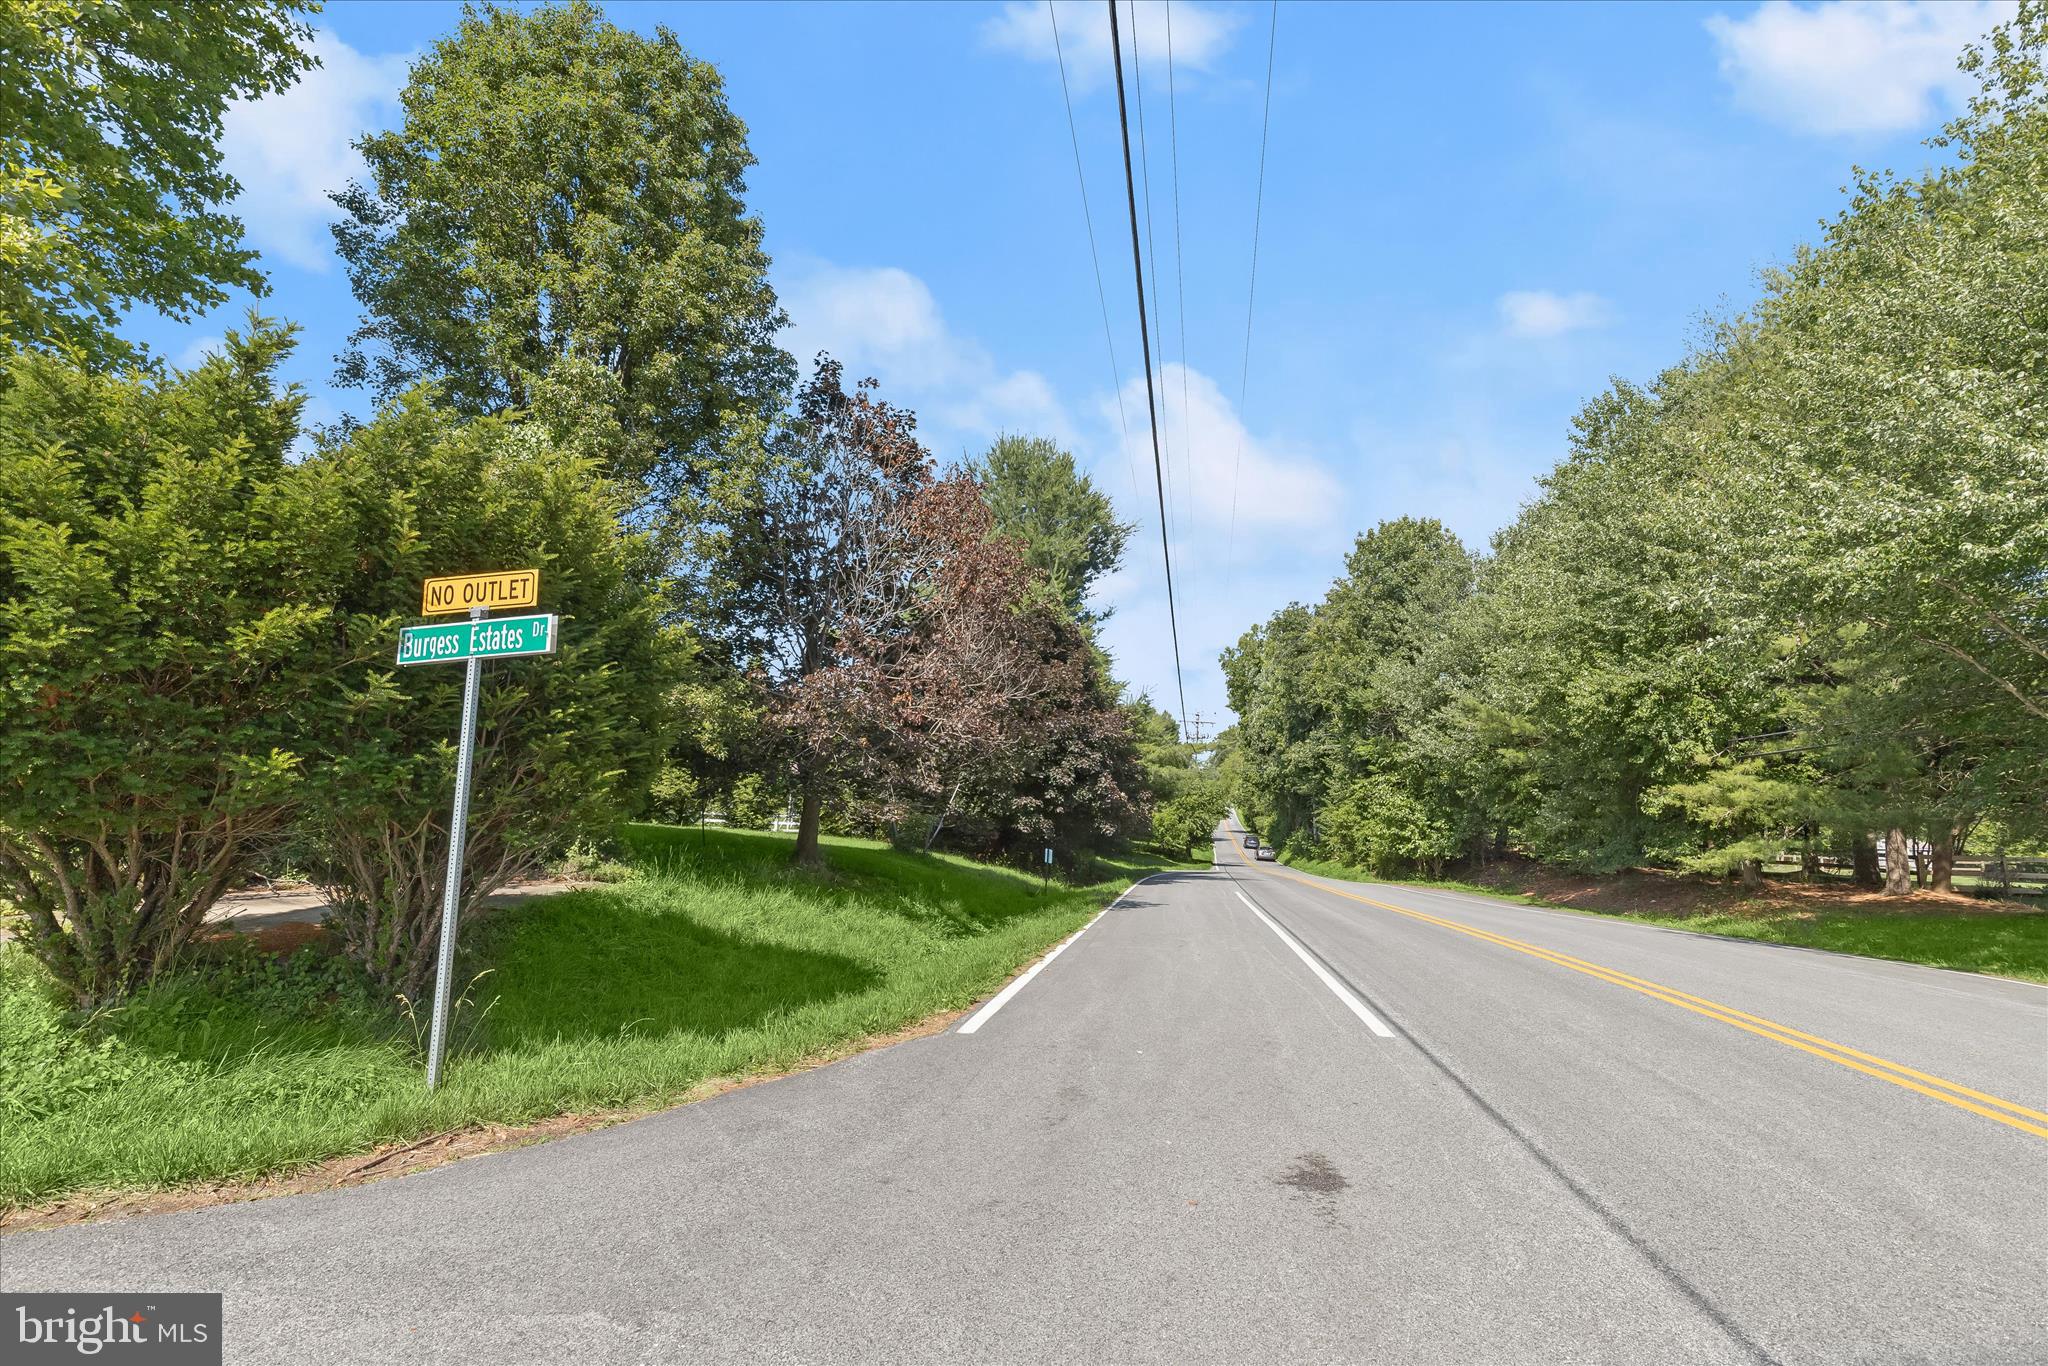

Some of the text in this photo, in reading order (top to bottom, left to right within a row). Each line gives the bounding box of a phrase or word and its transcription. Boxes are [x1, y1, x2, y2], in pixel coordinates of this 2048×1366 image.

[431, 578, 529, 606] NO OUTLET
[402, 621, 545, 659] Burgess Estates Dr
